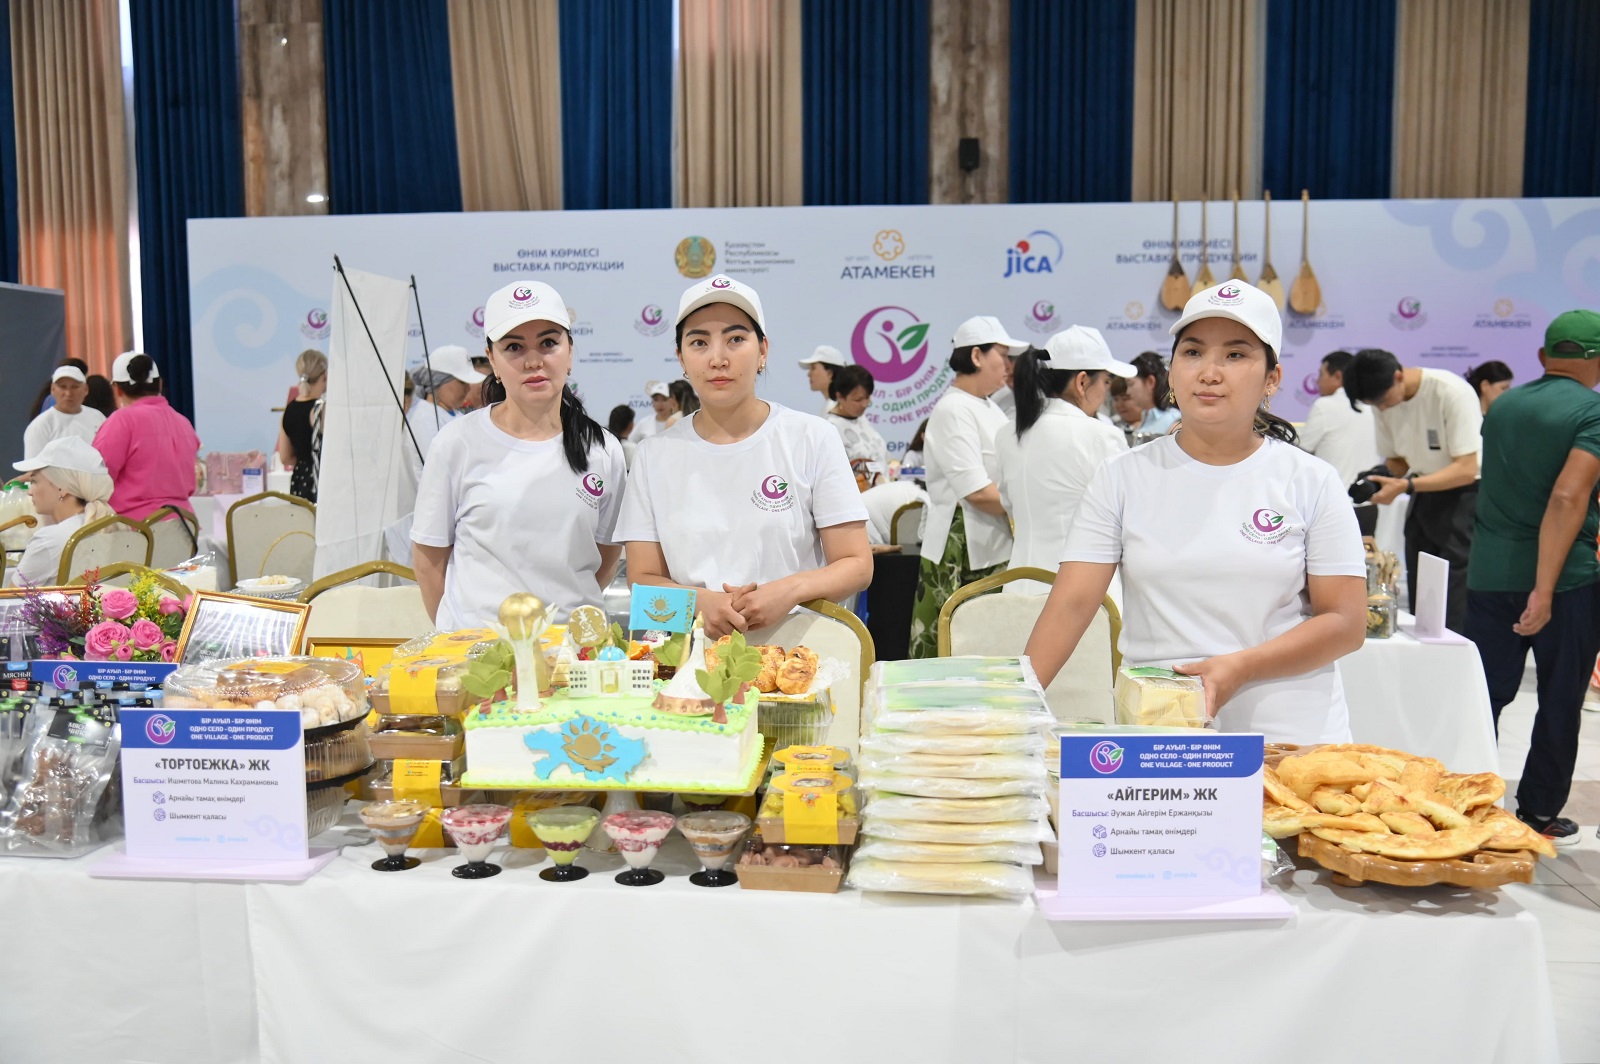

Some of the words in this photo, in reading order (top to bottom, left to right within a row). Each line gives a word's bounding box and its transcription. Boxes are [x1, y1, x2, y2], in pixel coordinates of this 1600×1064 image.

[493, 262, 550, 272] ВЫСТАВКА
[554, 261, 625, 272] ПРОДУКЦИИ
[840, 265, 935, 279] АТАМЕКЕН
[882, 398, 916, 411] ОДИН
[890, 413, 914, 423] ONE
[155, 758, 246, 771] «ТОРТОЕЖКА»
[248, 759, 271, 771] ЖК
[217, 795, 246, 803] өнімдері
[1107, 786, 1190, 801] «АЙГЕРИМ»
[1193, 788, 1218, 801] ЖК
[1110, 810, 1136, 818] Әужан
[1137, 809, 1167, 818] Айгерім
[1168, 809, 1213, 818] Ержанқызы
[1110, 828, 1139, 836] Арнайы
[1165, 828, 1197, 836] өнімдері
